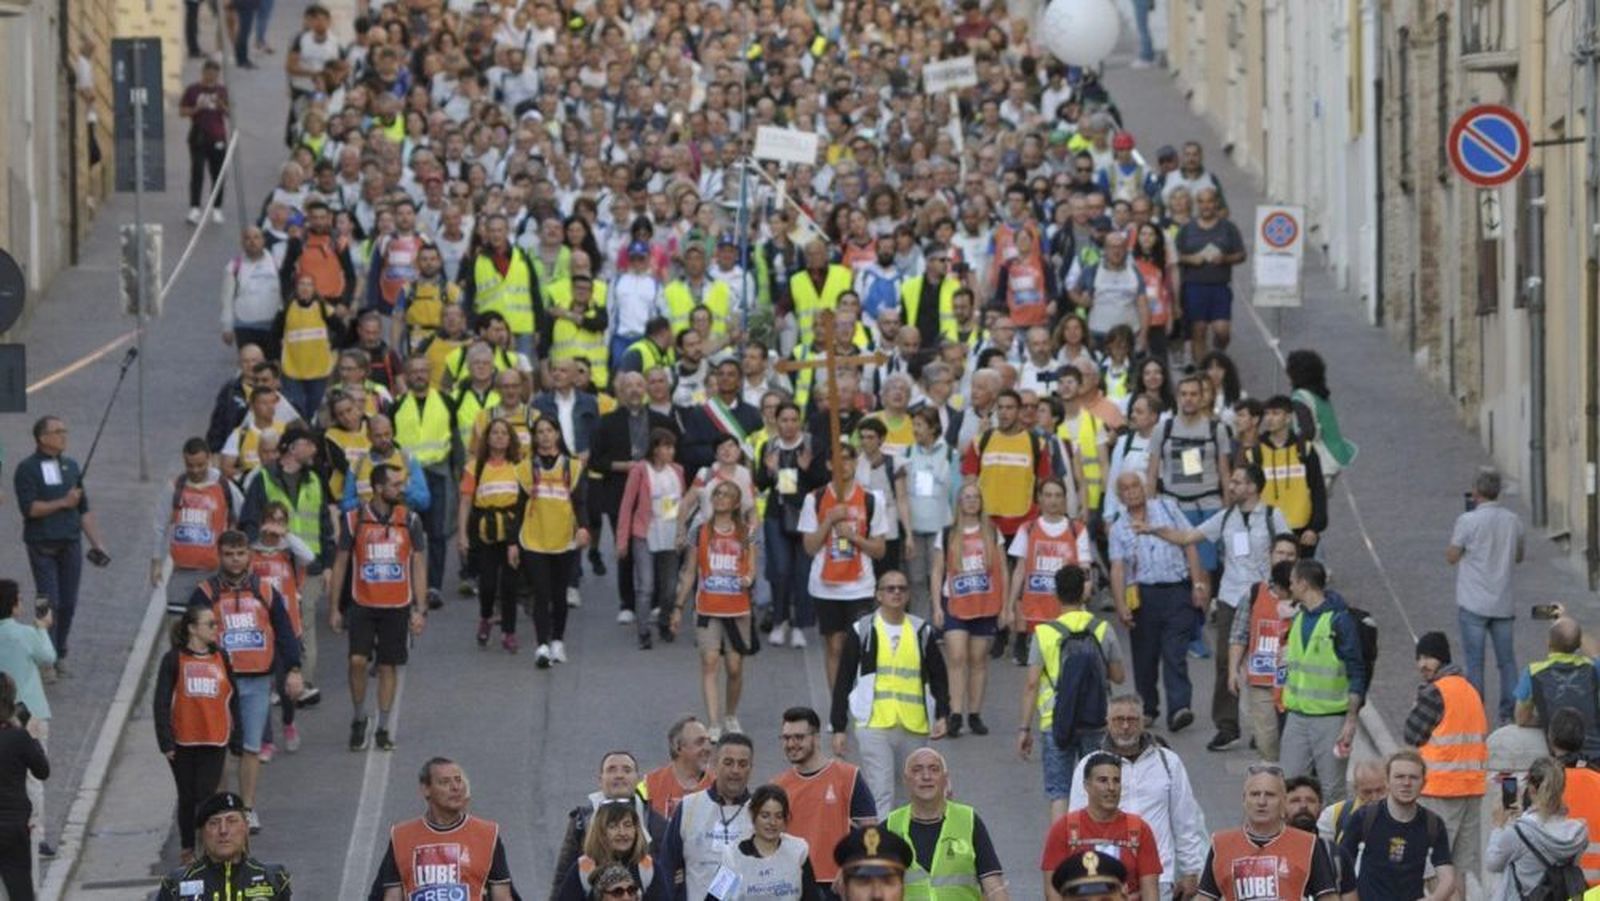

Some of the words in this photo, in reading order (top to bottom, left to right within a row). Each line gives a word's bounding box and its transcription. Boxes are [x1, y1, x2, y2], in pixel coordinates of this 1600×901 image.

[367, 543, 396, 559] LUBE
[225, 613, 256, 629] LUBE
[225, 631, 263, 645] CREO
[188, 678, 217, 694] LUBE
[417, 863, 457, 886] LUBE
[1236, 874, 1276, 900] LUBE
